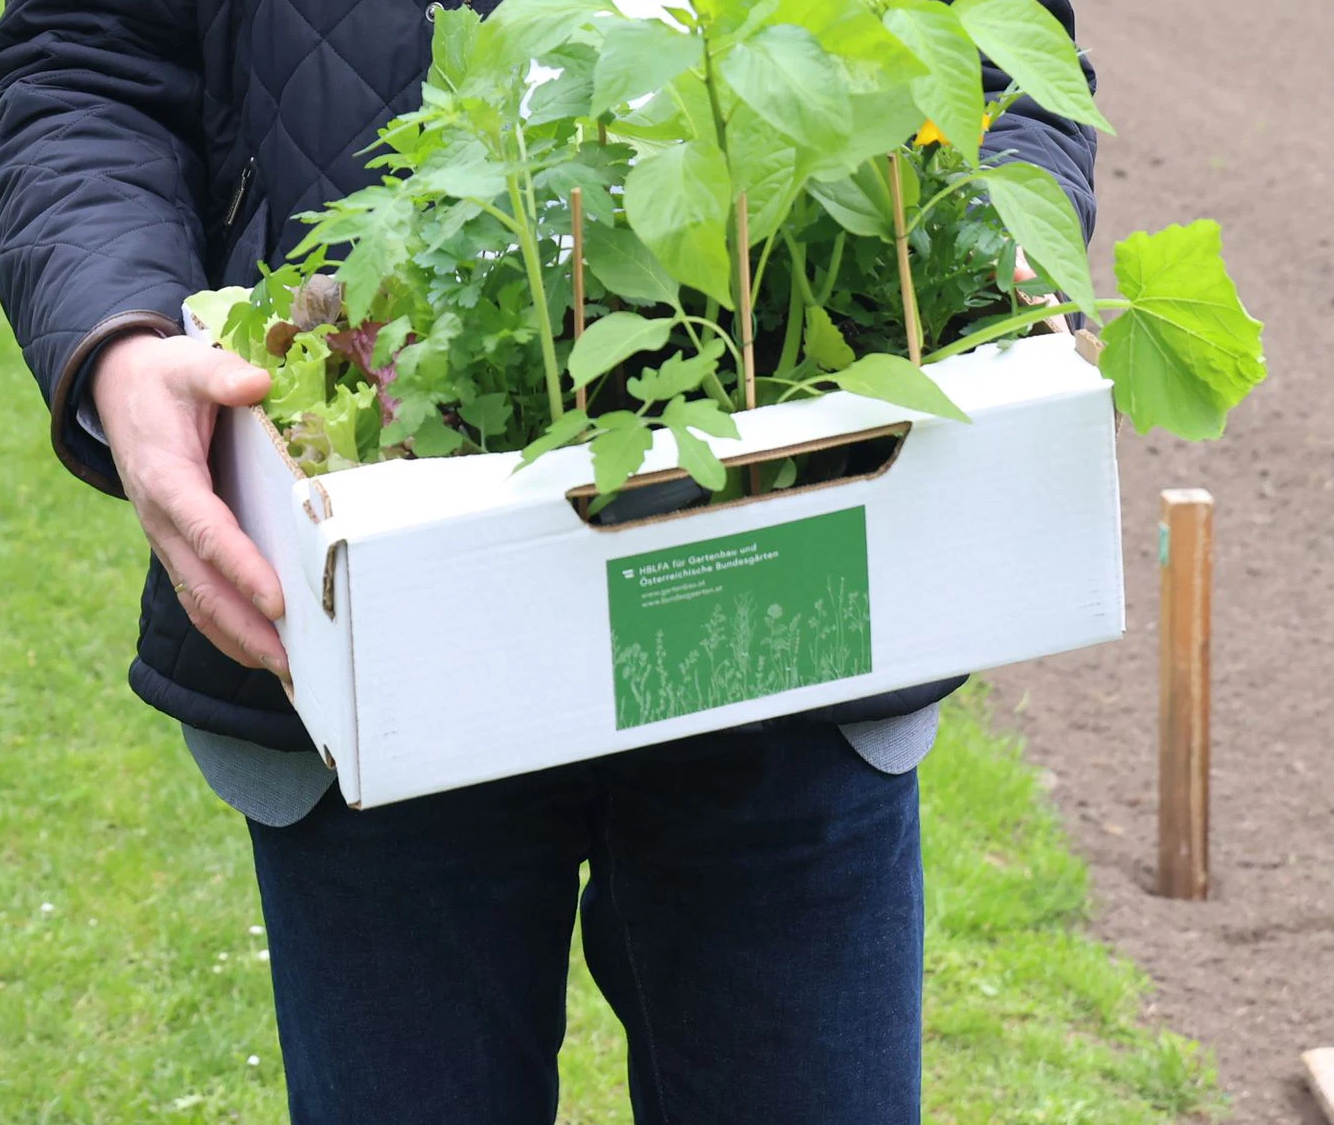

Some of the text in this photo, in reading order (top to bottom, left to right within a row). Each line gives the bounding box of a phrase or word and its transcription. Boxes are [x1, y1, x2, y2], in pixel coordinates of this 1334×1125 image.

[639, 542, 757, 575] HBLFA für Gartenbau und
[639, 550, 779, 587] Österreichische Bundesgärten
